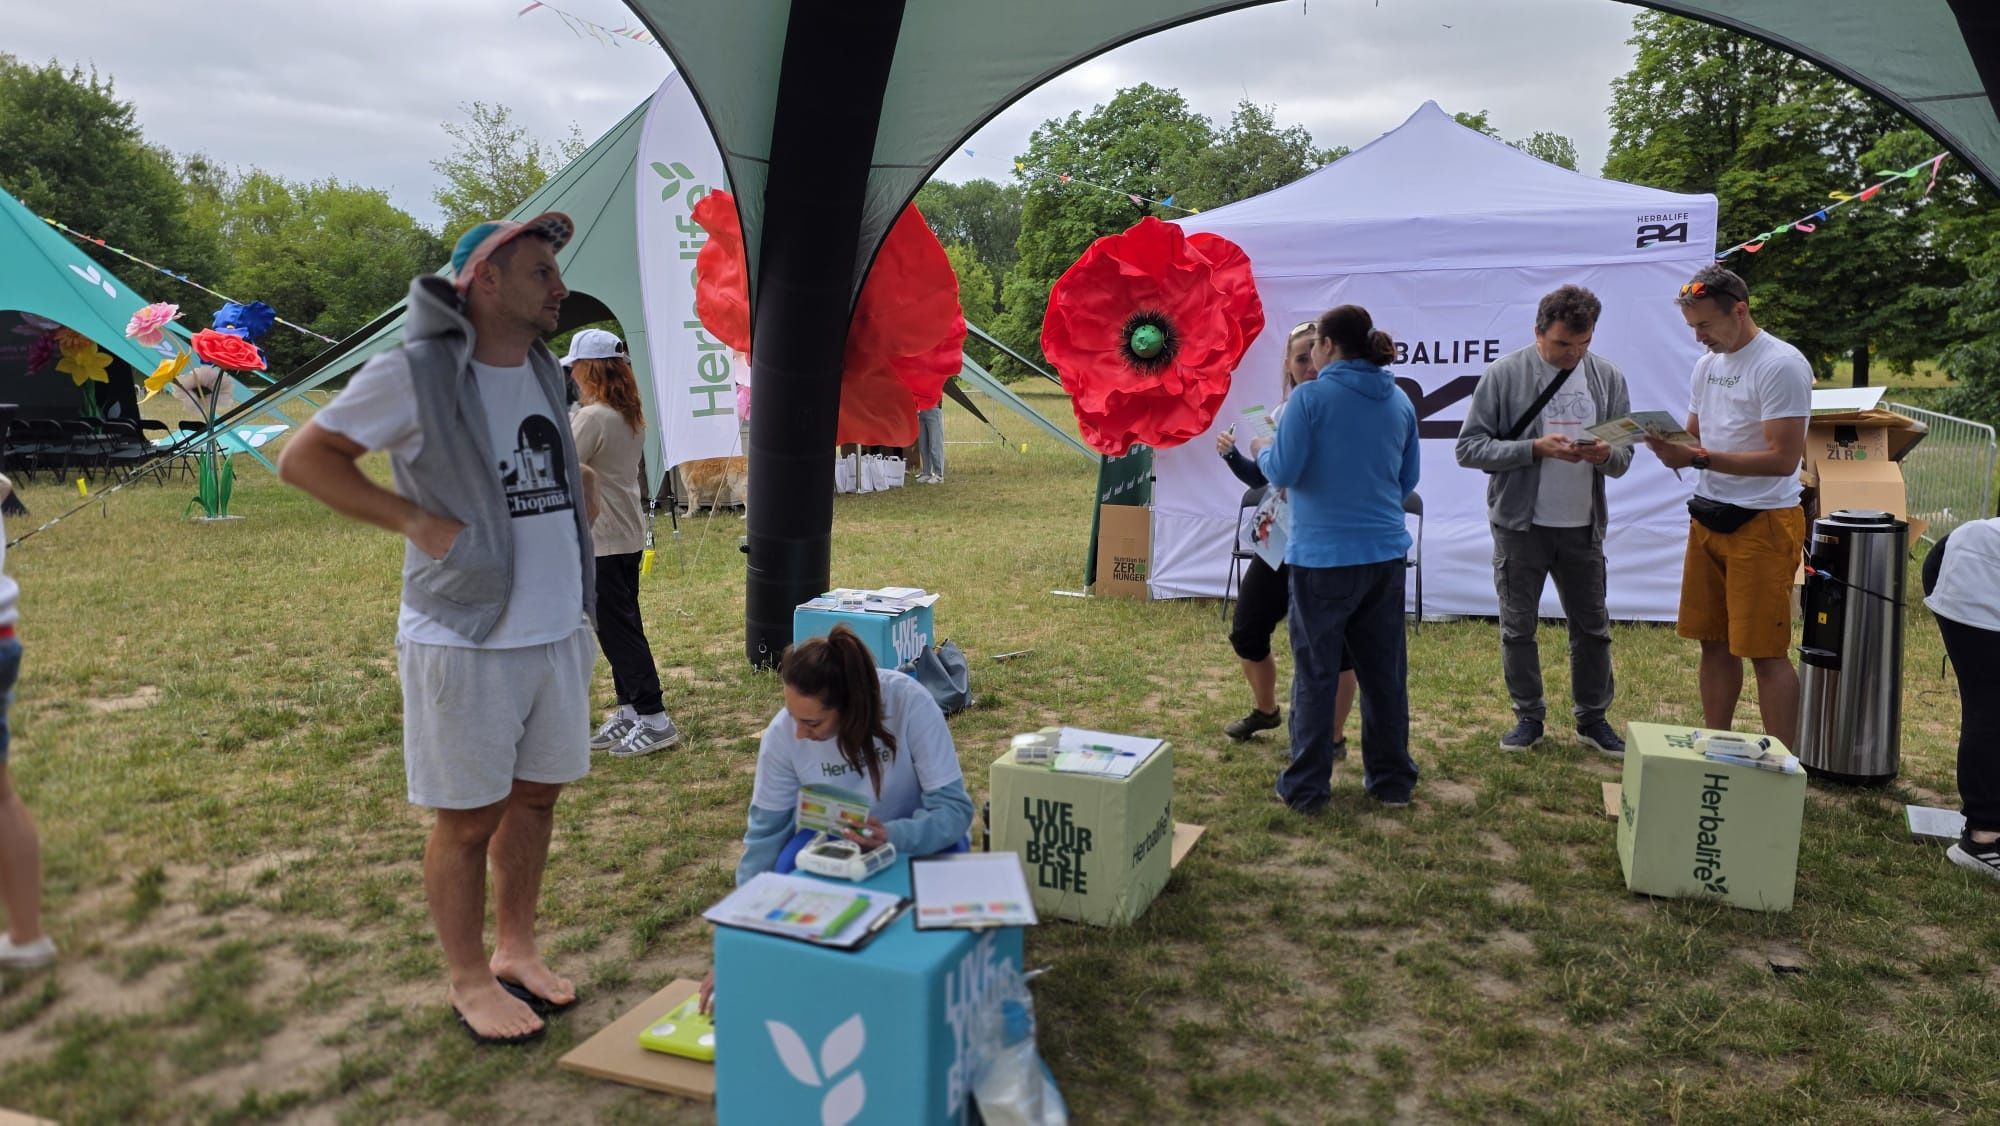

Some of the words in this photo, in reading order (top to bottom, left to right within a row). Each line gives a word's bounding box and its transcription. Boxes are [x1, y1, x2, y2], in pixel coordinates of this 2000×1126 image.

[1637, 212, 1689, 223] HERBALIFE
[1636, 222, 1688, 249] 24
[1392, 339, 1500, 365] BALIFE
[510, 492, 566, 513] hopina
[1113, 573, 1145, 582] HUNGER
[892, 616, 918, 648] LIVE
[1024, 796, 1073, 825] LIVE
[1029, 815, 1092, 851] YOUR
[1132, 815, 1167, 868] Herbalife
[1693, 773, 1730, 883] Herbalife
[1026, 840, 1085, 872] BEST
[1039, 864, 1087, 894] LIFE
